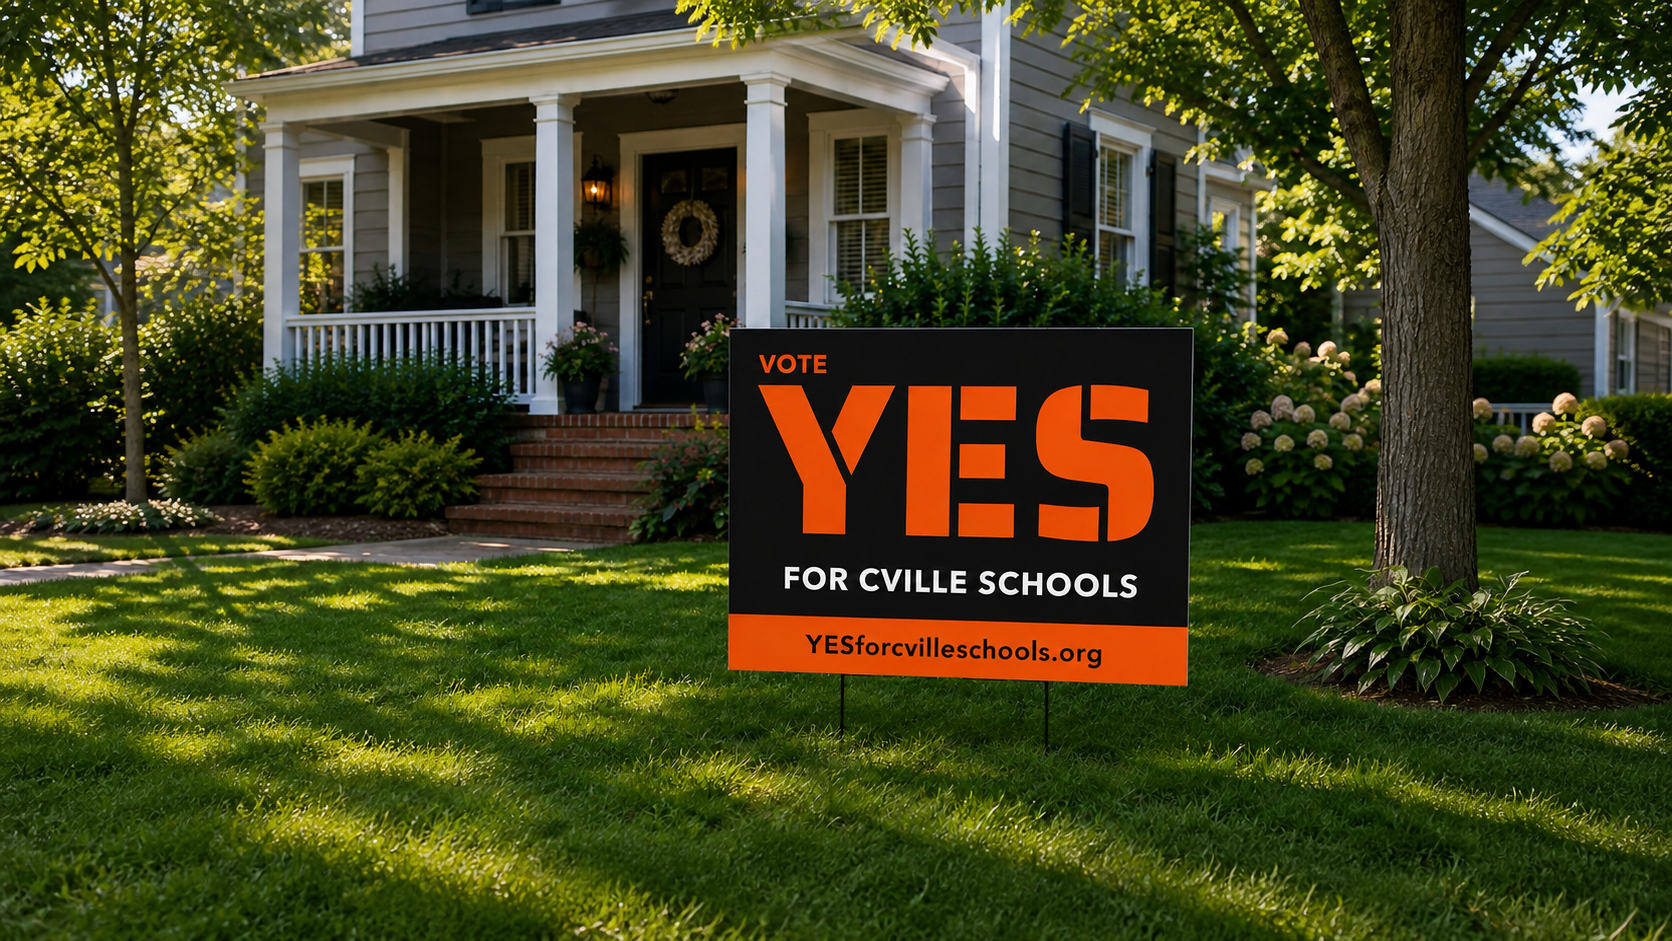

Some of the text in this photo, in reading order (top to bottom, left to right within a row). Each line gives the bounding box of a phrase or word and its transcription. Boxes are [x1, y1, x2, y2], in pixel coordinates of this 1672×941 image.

[759, 354, 826, 373] VOTE
[758, 385, 1154, 541] YES
[785, 567, 1137, 598] FOR CVILLE SCHOOLS
[806, 634, 1102, 669] YESforcvilleschools.org
